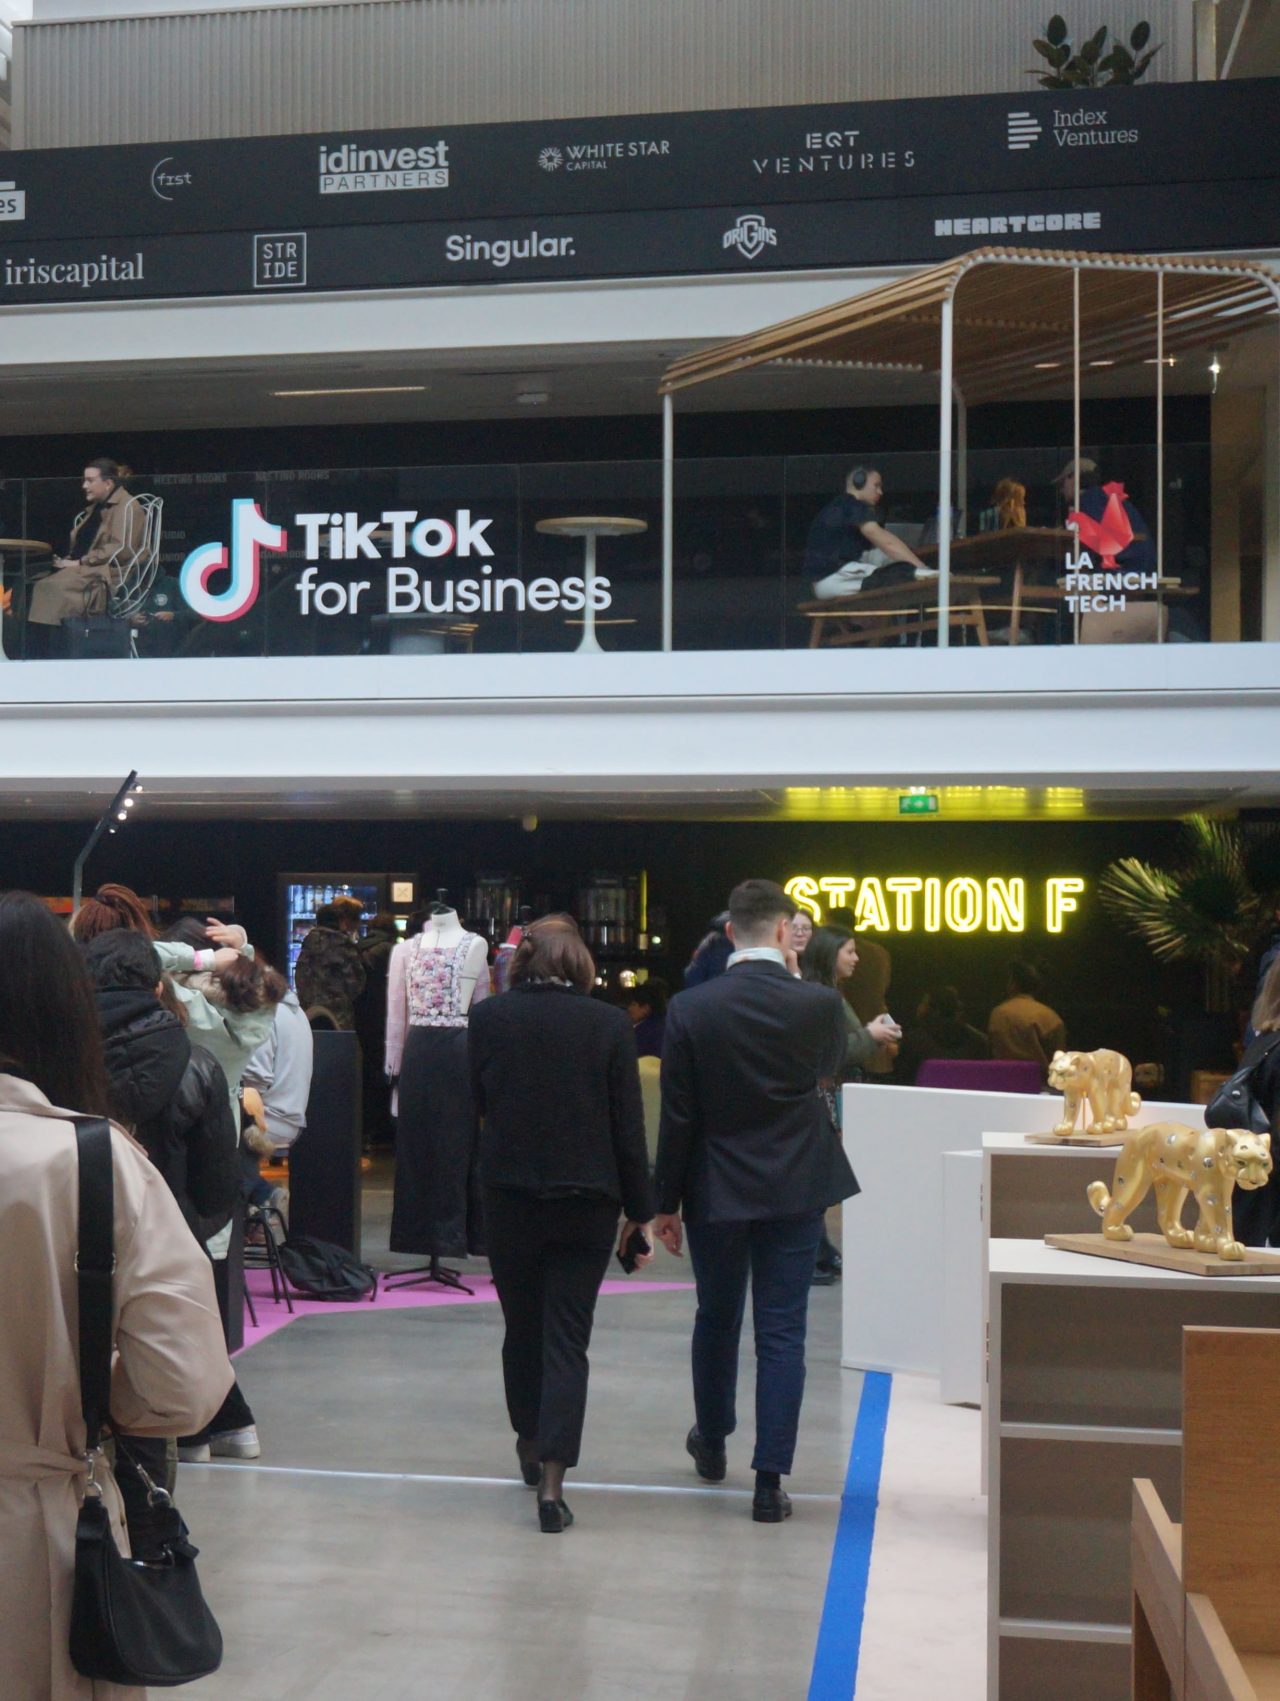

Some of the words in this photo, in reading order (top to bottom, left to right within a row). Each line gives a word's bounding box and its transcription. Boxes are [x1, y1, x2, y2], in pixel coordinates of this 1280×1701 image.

[1053, 110, 1108, 127] Index
[806, 130, 860, 149] EQT
[1053, 127, 1138, 147] Ventures
[320, 140, 449, 174] idinvest
[566, 143, 624, 160] WHITE
[628, 140, 670, 157] STAR
[566, 160, 608, 171] CAPITAL
[752, 151, 915, 174] VENTURES
[323, 171, 447, 191] PARTNERS
[934, 212, 1101, 236] HEARTCORE
[263, 243, 297, 259] STR
[446, 231, 576, 267] Singular.
[5, 253, 145, 287] iriscapital
[263, 262, 298, 279] IDE
[295, 509, 495, 560] TikTok
[1065, 551, 1094, 570] LA
[295, 567, 371, 615] for
[387, 564, 612, 613] Business
[1065, 572, 1158, 591] FRENCH
[1064, 594, 1126, 613] TECH
[783, 876, 1025, 933] STATION
[1045, 877, 1086, 933] F
